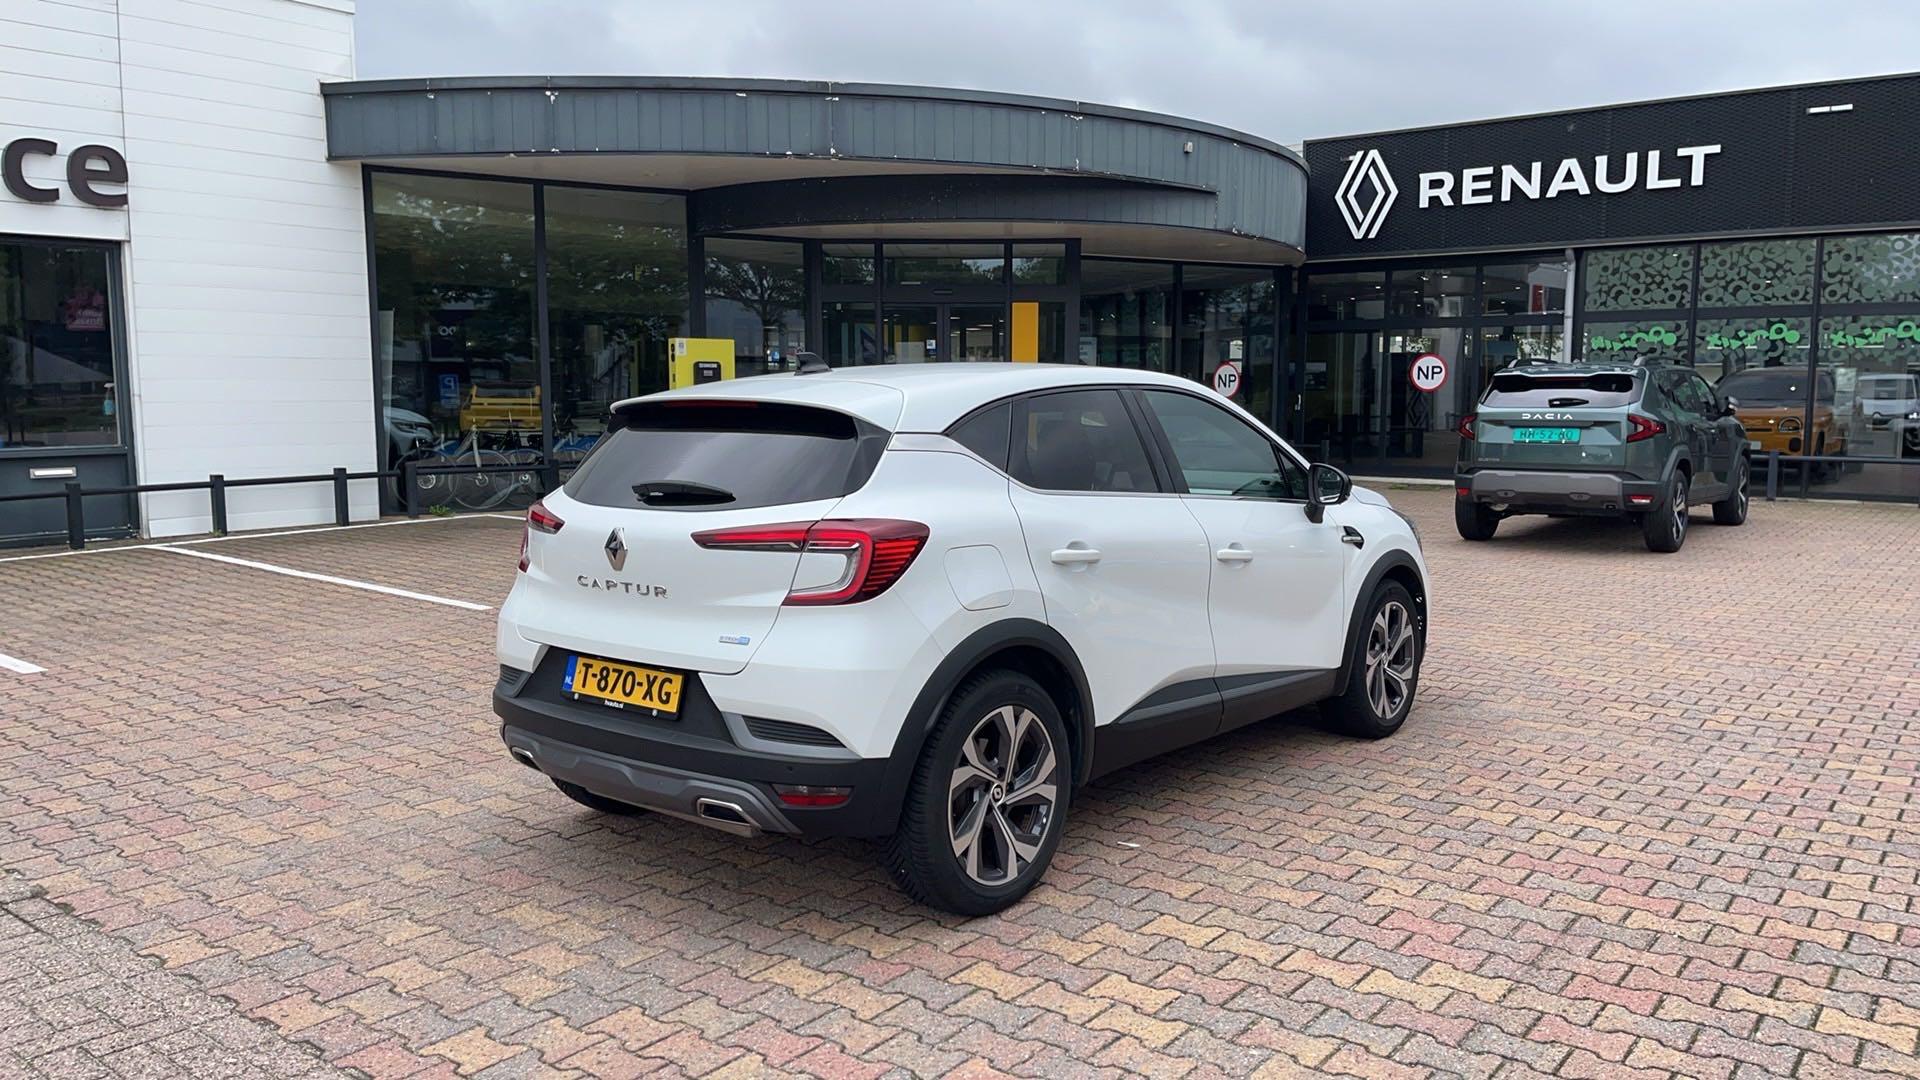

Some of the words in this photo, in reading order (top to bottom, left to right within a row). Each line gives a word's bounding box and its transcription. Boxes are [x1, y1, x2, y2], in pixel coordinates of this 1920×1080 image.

[1418, 144, 1722, 208] RENAULT
[1417, 365, 1443, 380] NP
[1217, 373, 1237, 389] NP
[1521, 412, 1574, 420] DACIA
[577, 575, 668, 598] CAPTUR
[564, 675, 572, 685] NL
[581, 662, 673, 705] T-870-XG
